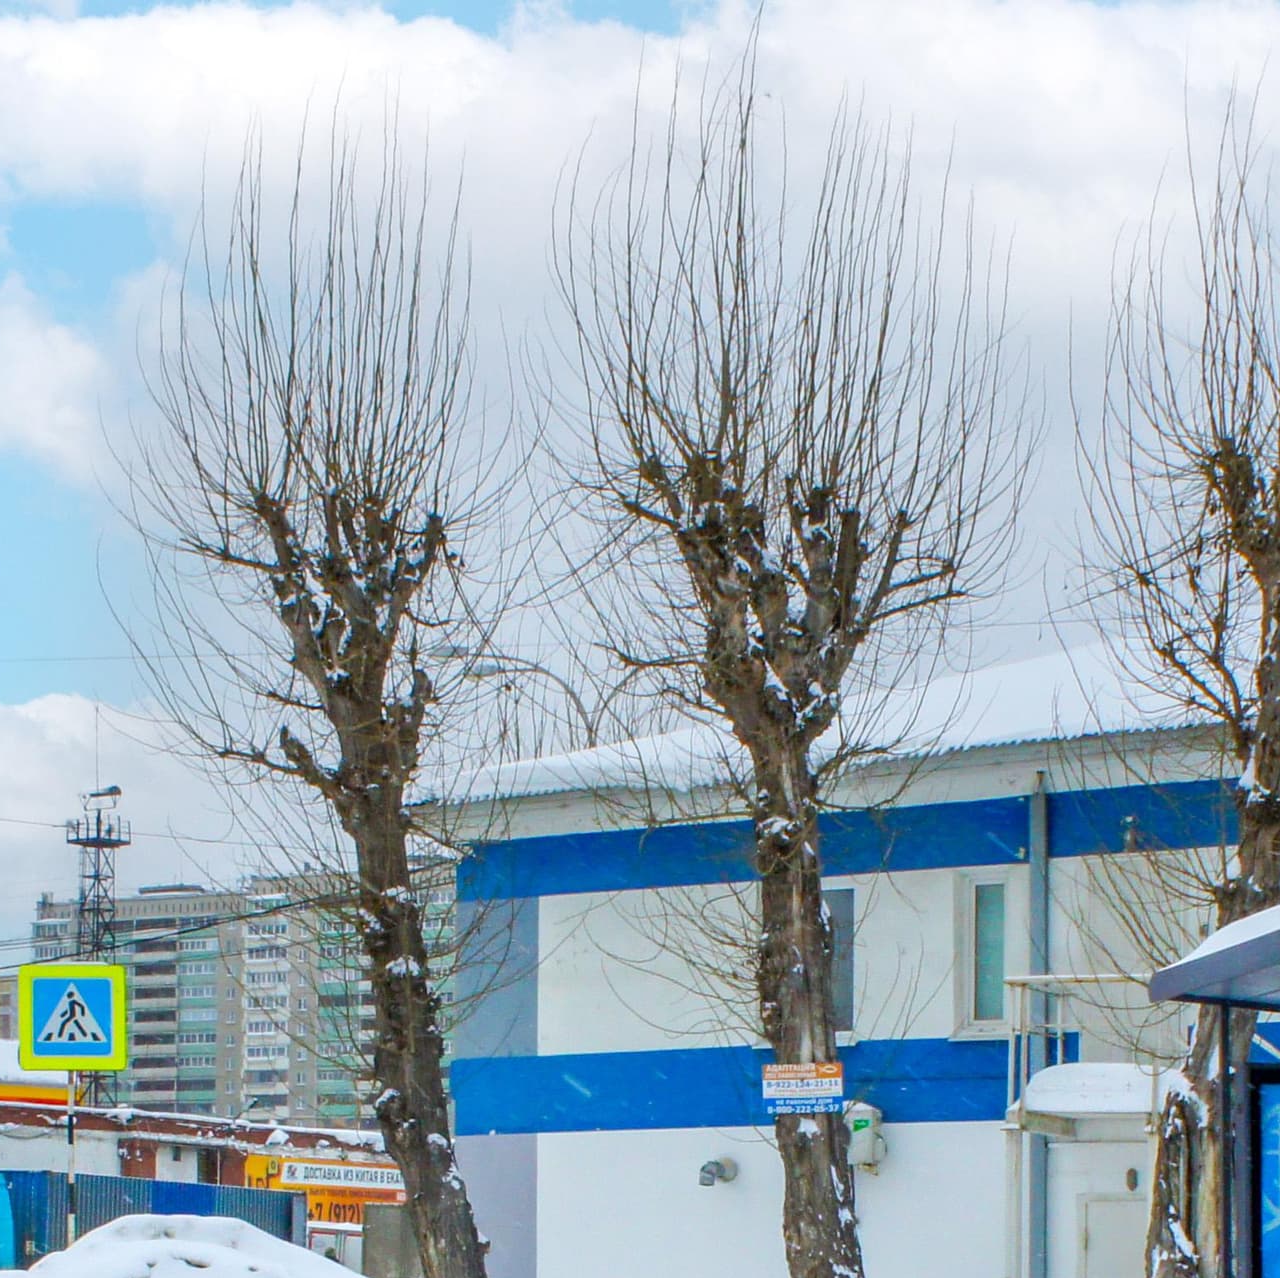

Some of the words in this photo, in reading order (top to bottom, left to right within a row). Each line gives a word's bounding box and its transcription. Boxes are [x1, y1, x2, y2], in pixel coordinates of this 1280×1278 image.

[303, 1166, 341, 1180] ДОСТАВКА
[343, 1168, 354, 1181] ИЗ
[355, 1169, 378, 1182] КИТАЯ
